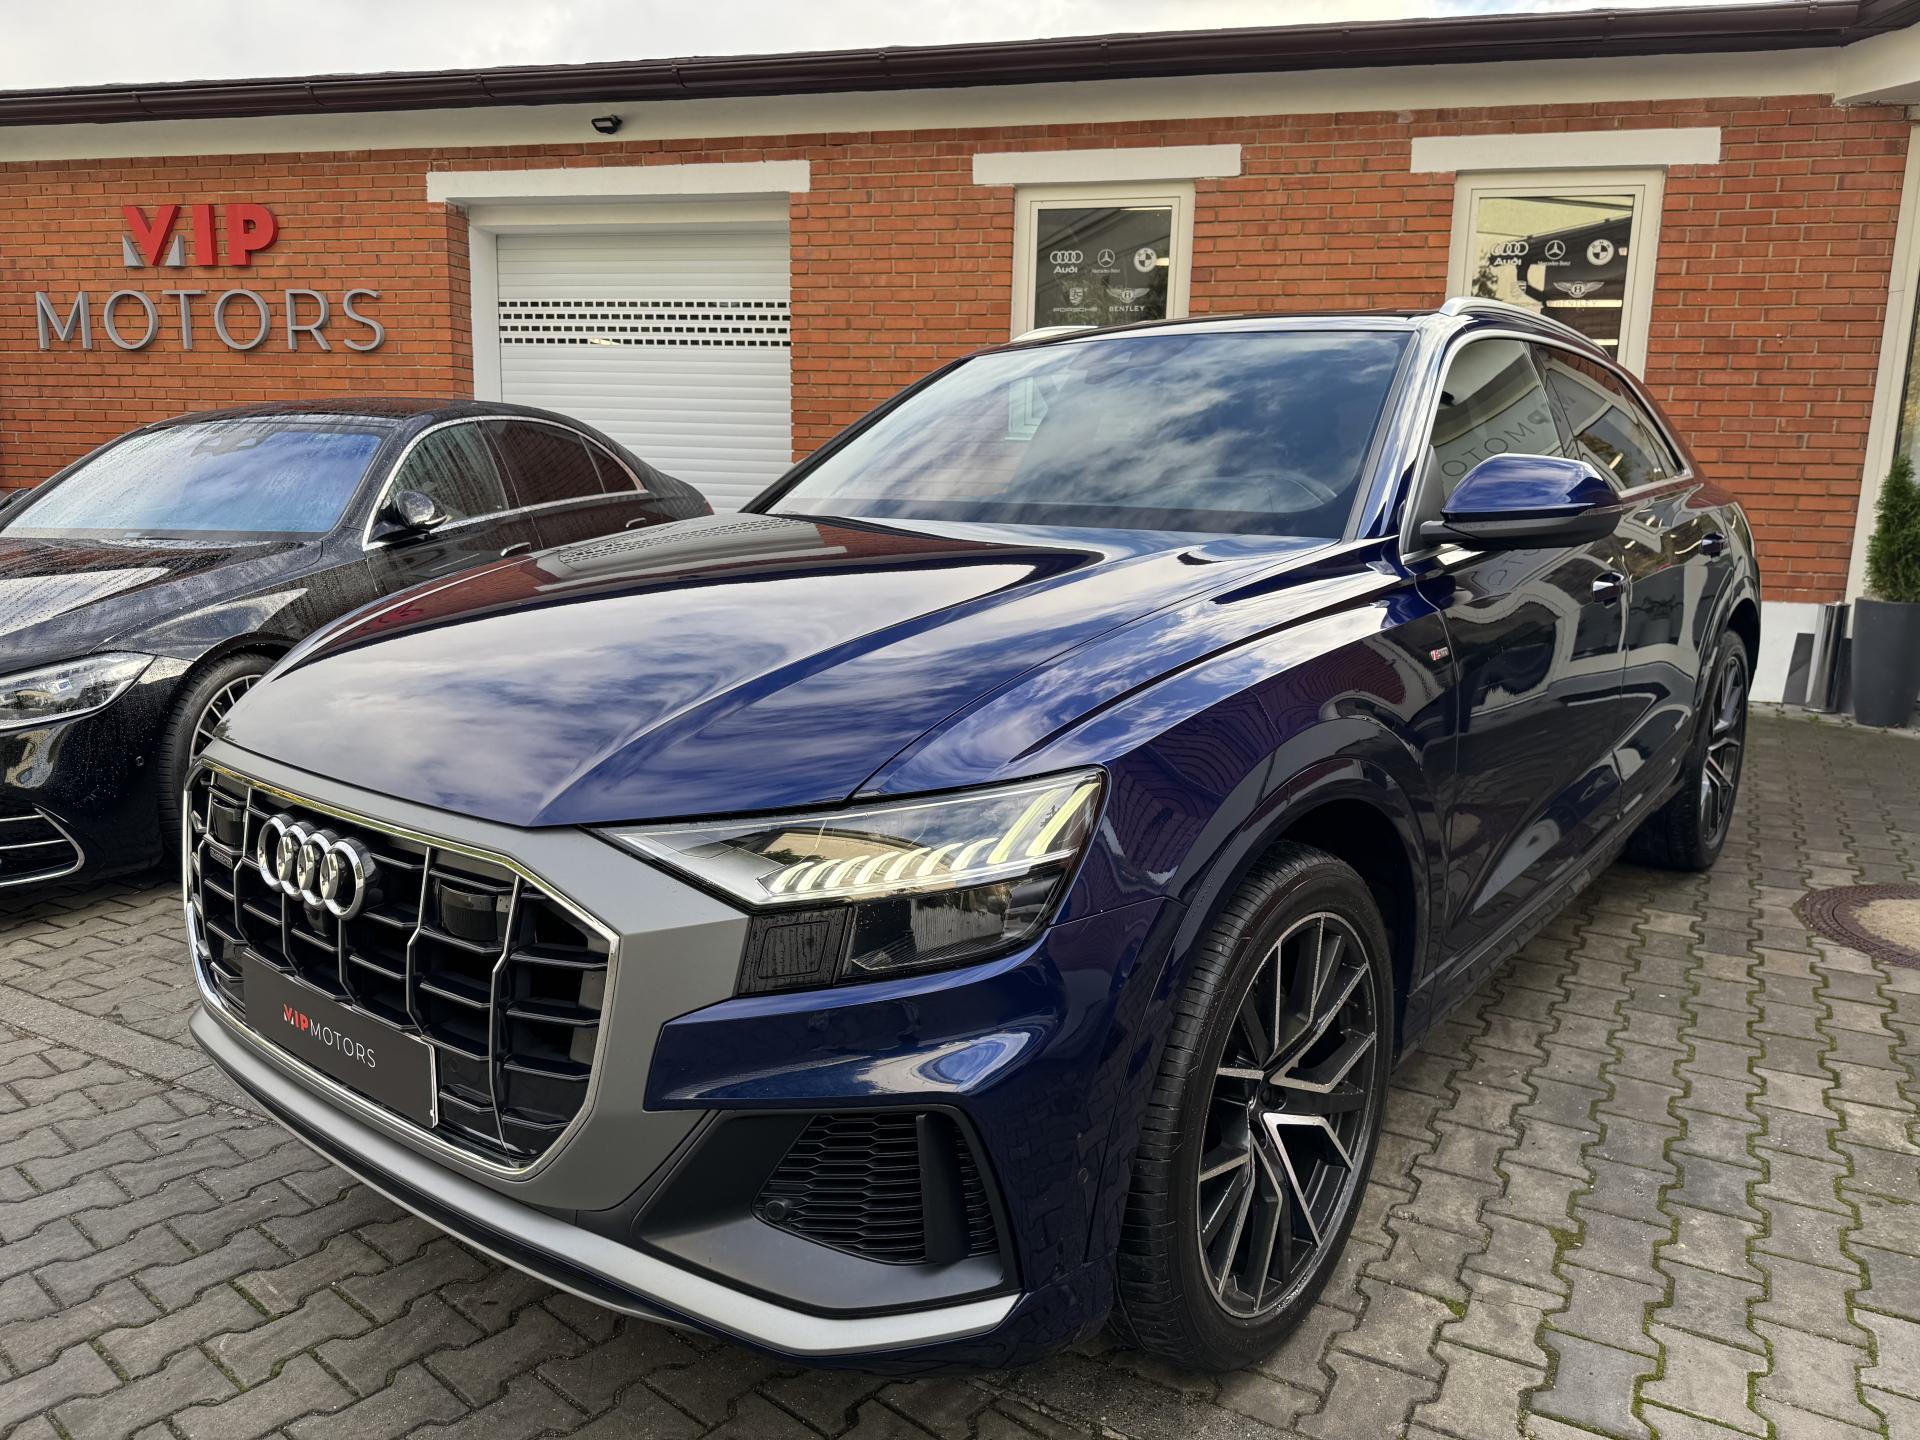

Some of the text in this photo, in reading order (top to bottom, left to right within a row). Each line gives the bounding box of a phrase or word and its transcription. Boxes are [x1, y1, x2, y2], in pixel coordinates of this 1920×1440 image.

[122, 203, 279, 267] VIP
[1493, 257, 1522, 266] Audi
[1053, 265, 1078, 274] Audi
[35, 288, 386, 352] MOTORS
[283, 1003, 376, 1068] VIP MOTORS
